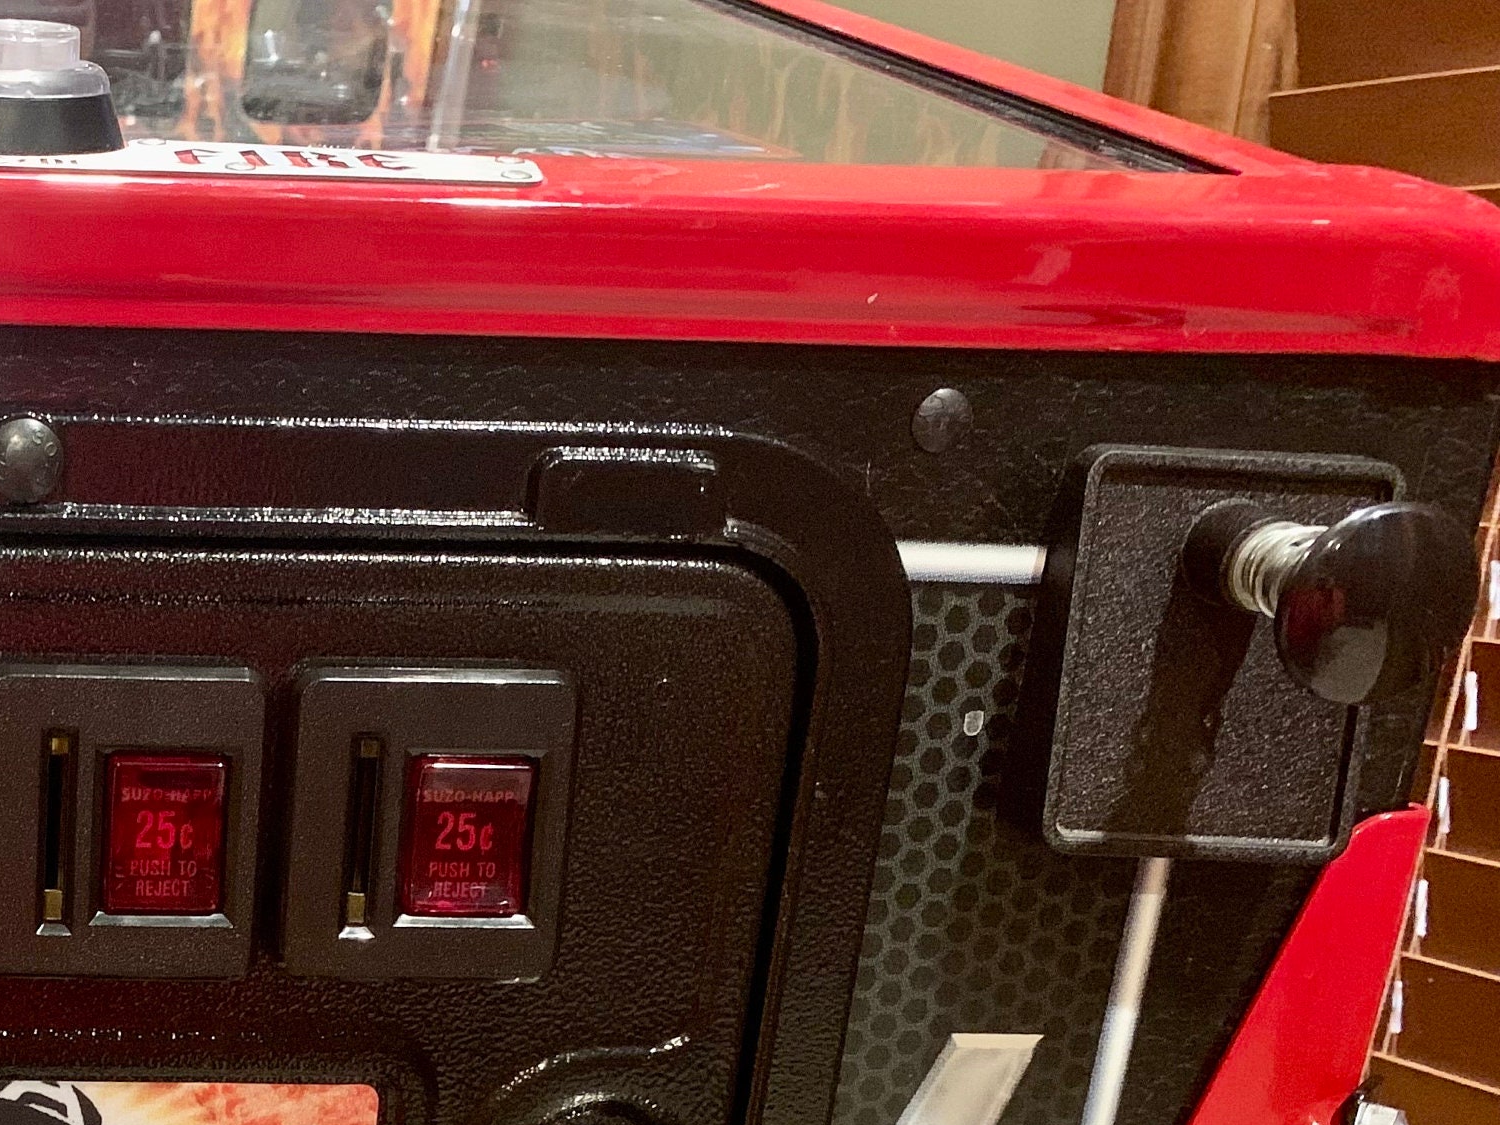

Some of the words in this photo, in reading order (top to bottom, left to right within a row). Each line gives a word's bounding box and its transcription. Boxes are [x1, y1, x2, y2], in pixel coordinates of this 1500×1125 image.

[164, 148, 412, 170] FIRE
[135, 810, 194, 853] 25¢
[435, 811, 494, 855] 25¢
[129, 859, 171, 877] PUSH
[177, 860, 198, 877] TO
[428, 862, 470, 878] PUSH
[476, 862, 496, 878] TO
[135, 879, 190, 897] REJECT
[433, 881, 487, 898] REJECT
